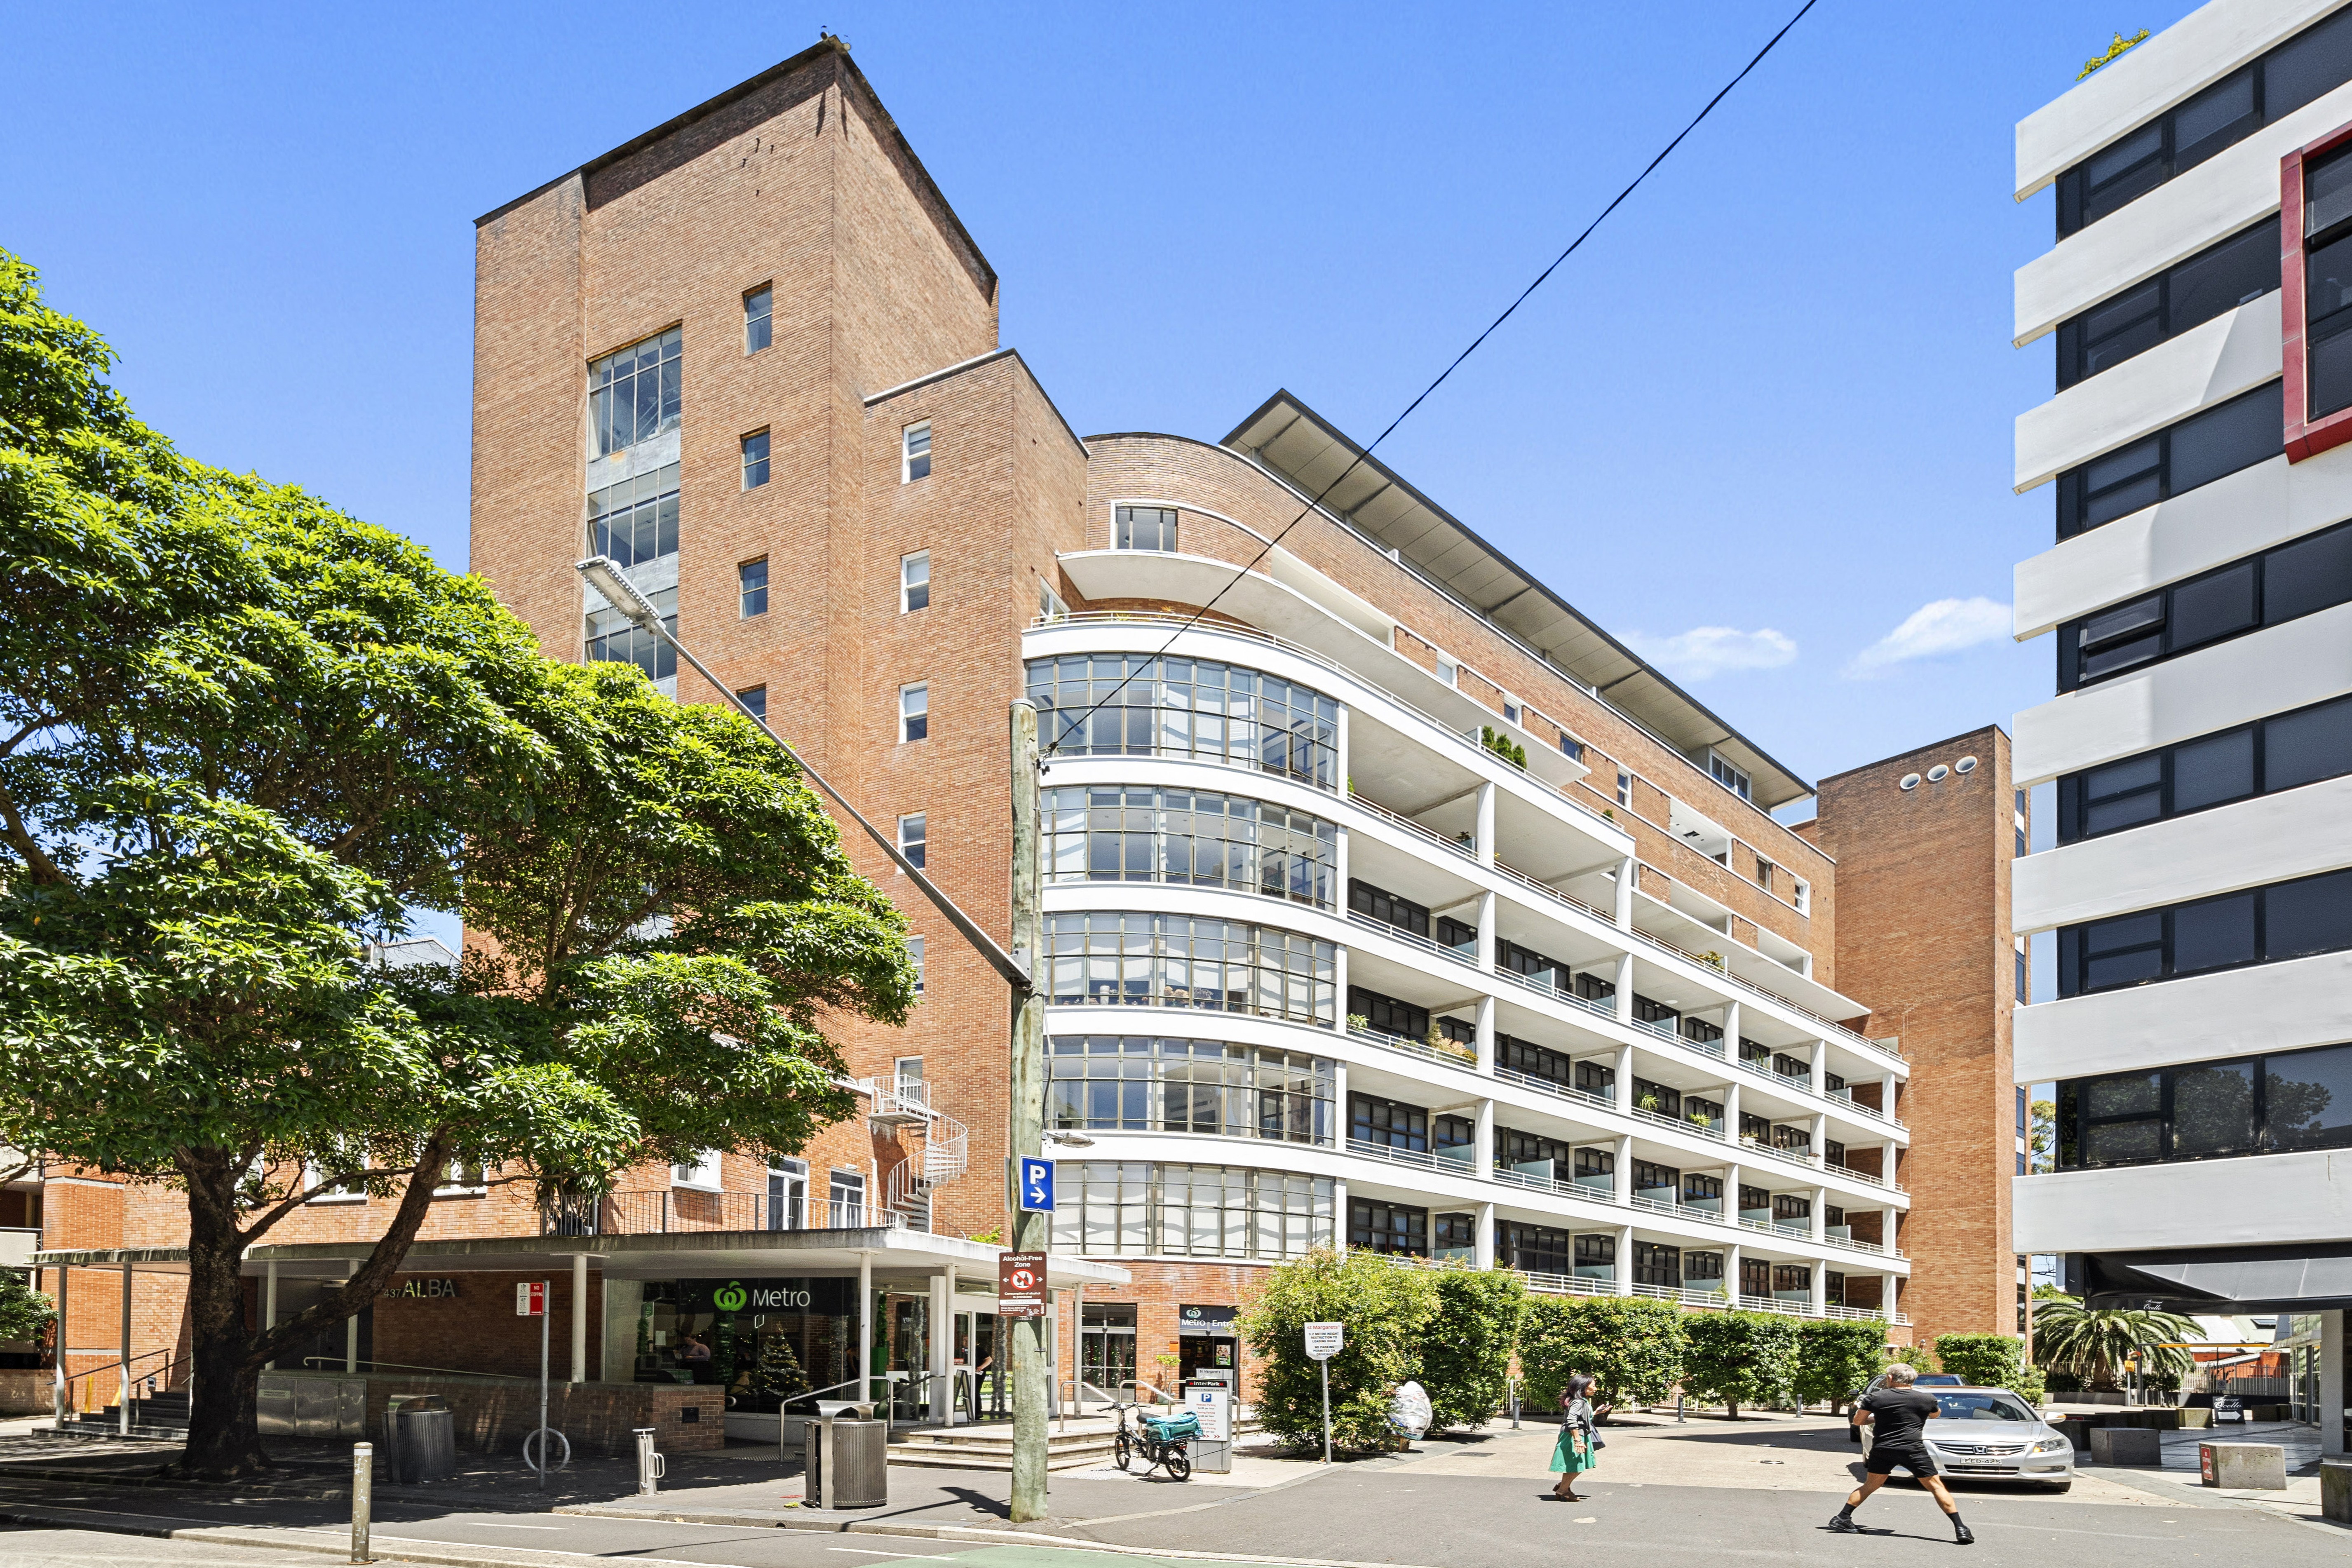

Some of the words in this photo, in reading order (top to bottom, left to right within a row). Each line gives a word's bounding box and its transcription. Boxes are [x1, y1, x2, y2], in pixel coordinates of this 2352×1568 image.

[1030, 1165, 1046, 1184] P
[402, 1279, 455, 1297] ALBA
[753, 1287, 810, 1307] Metro
